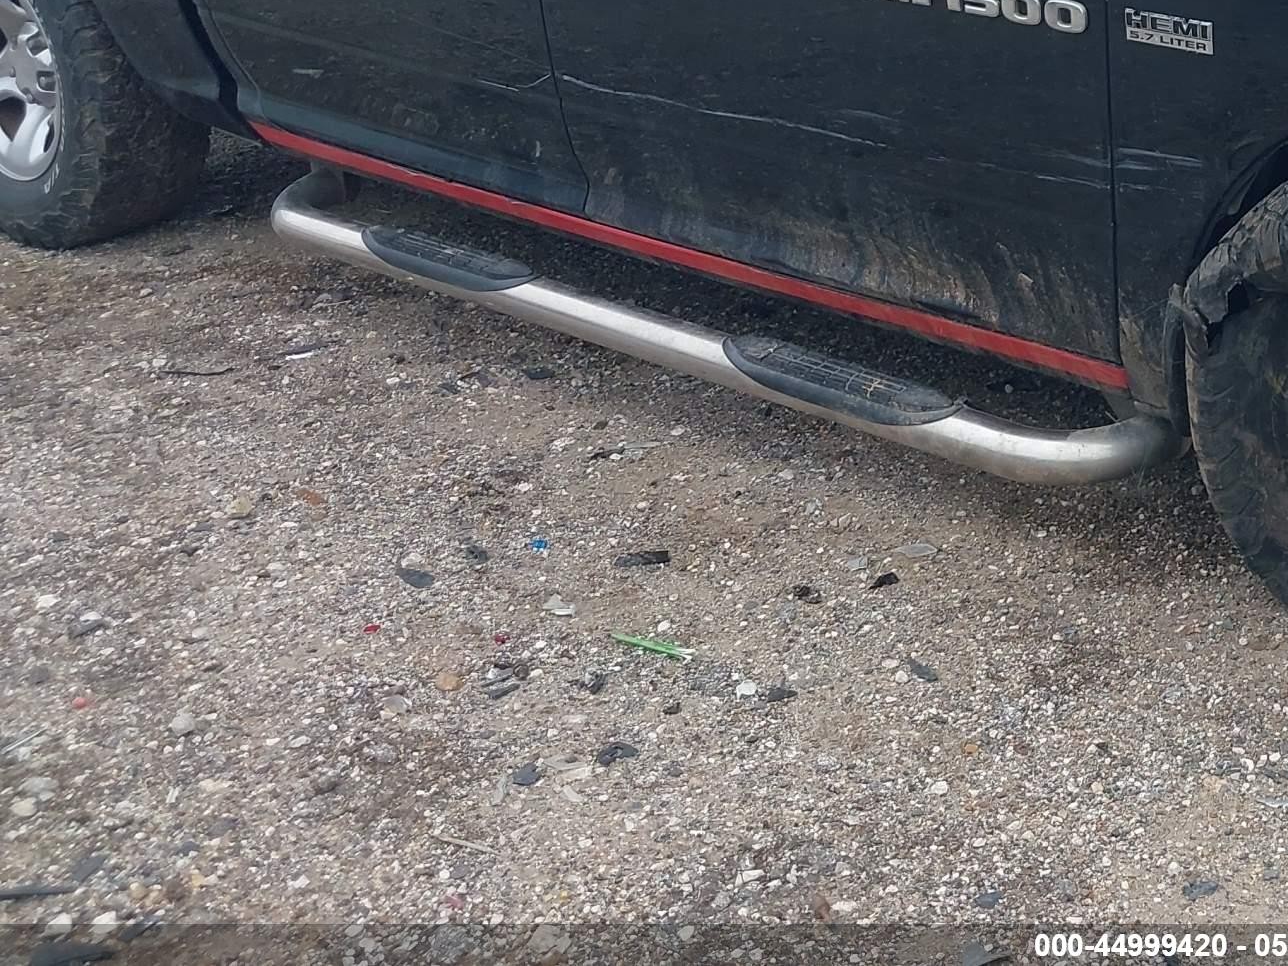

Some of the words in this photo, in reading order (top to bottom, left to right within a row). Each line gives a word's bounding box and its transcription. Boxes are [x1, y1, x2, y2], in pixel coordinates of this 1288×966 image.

[1125, 7, 1213, 41] HEMI
[1129, 30, 1154, 42] 5.7
[1159, 35, 1207, 52] LITER
